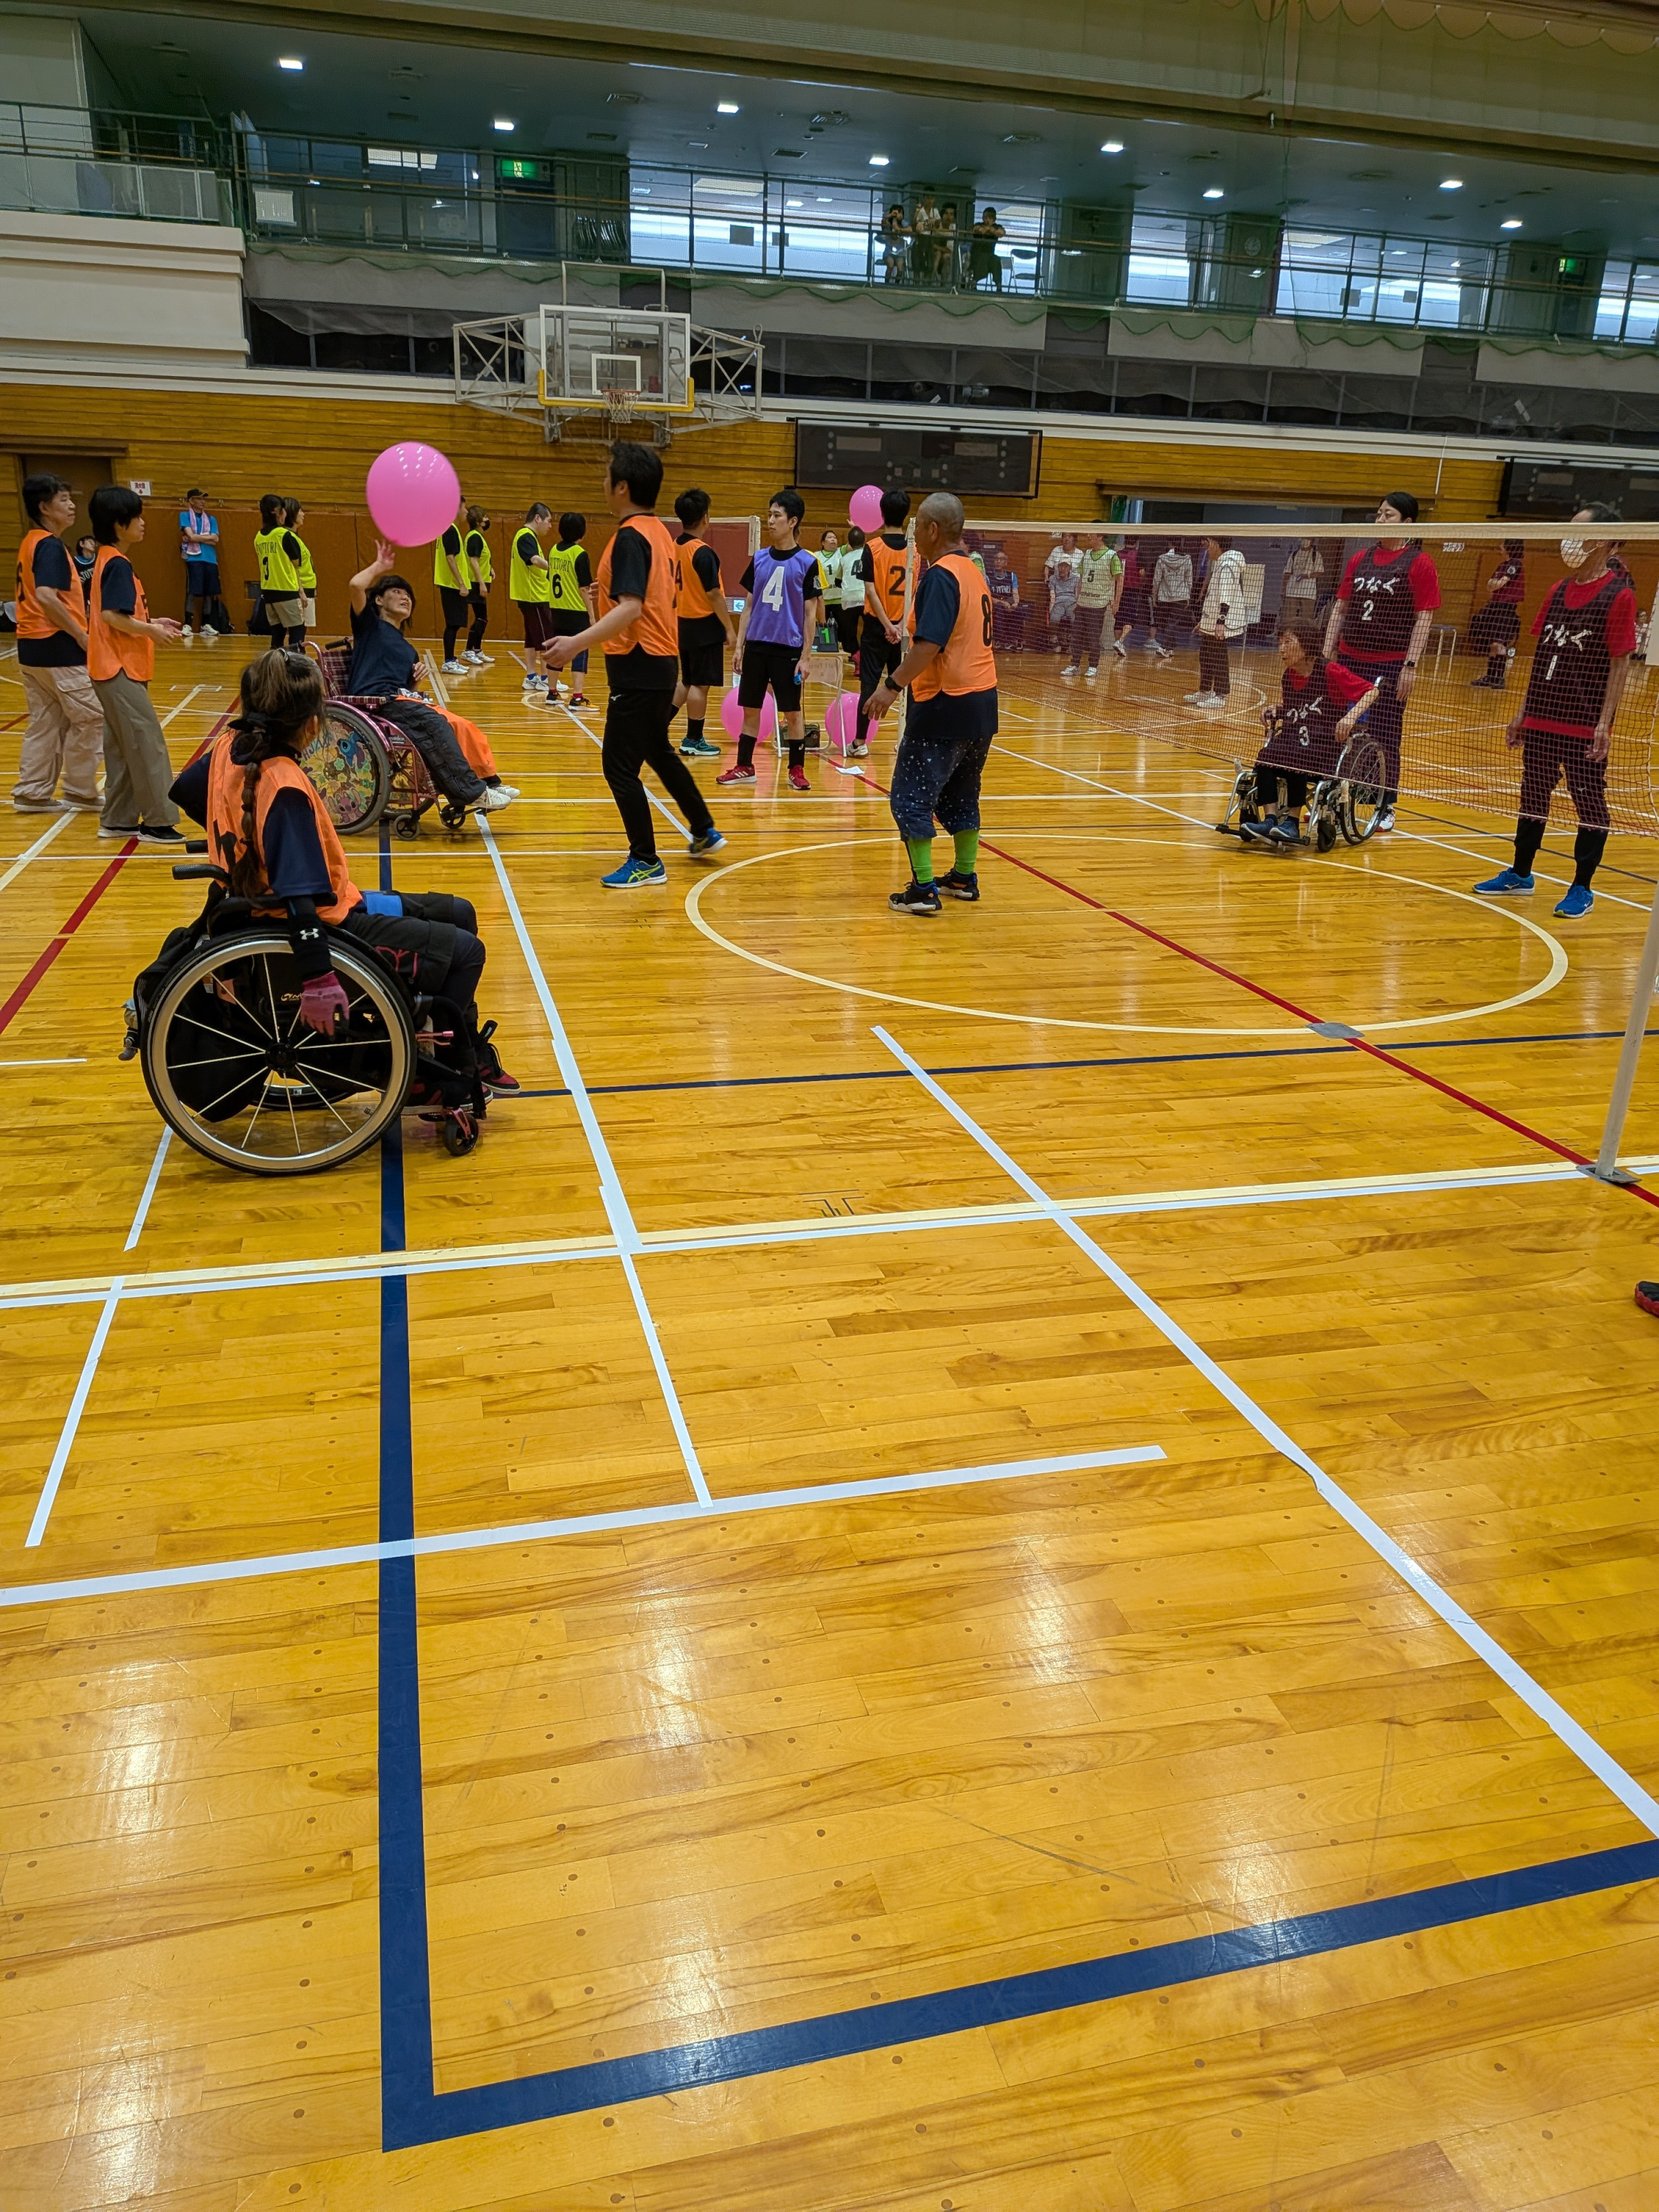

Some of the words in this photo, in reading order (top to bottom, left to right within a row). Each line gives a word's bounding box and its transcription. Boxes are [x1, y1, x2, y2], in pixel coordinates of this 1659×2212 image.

[262, 556, 270, 581] 3
[675, 560, 683, 591] 4
[826, 564, 833, 576] 1
[888, 565, 906, 596] 2
[1087, 570, 1096, 583] 5
[552, 573, 563, 599] 6
[762, 565, 785, 612] 4
[1354, 577, 1400, 595] つなぐ
[981, 593, 993, 647] 8
[1362, 599, 1374, 621] 2
[821, 628, 830, 644] 1
[1543, 624, 1592, 652] つなぐ
[1545, 655, 1558, 681] 1
[1299, 726, 1310, 746] 3
